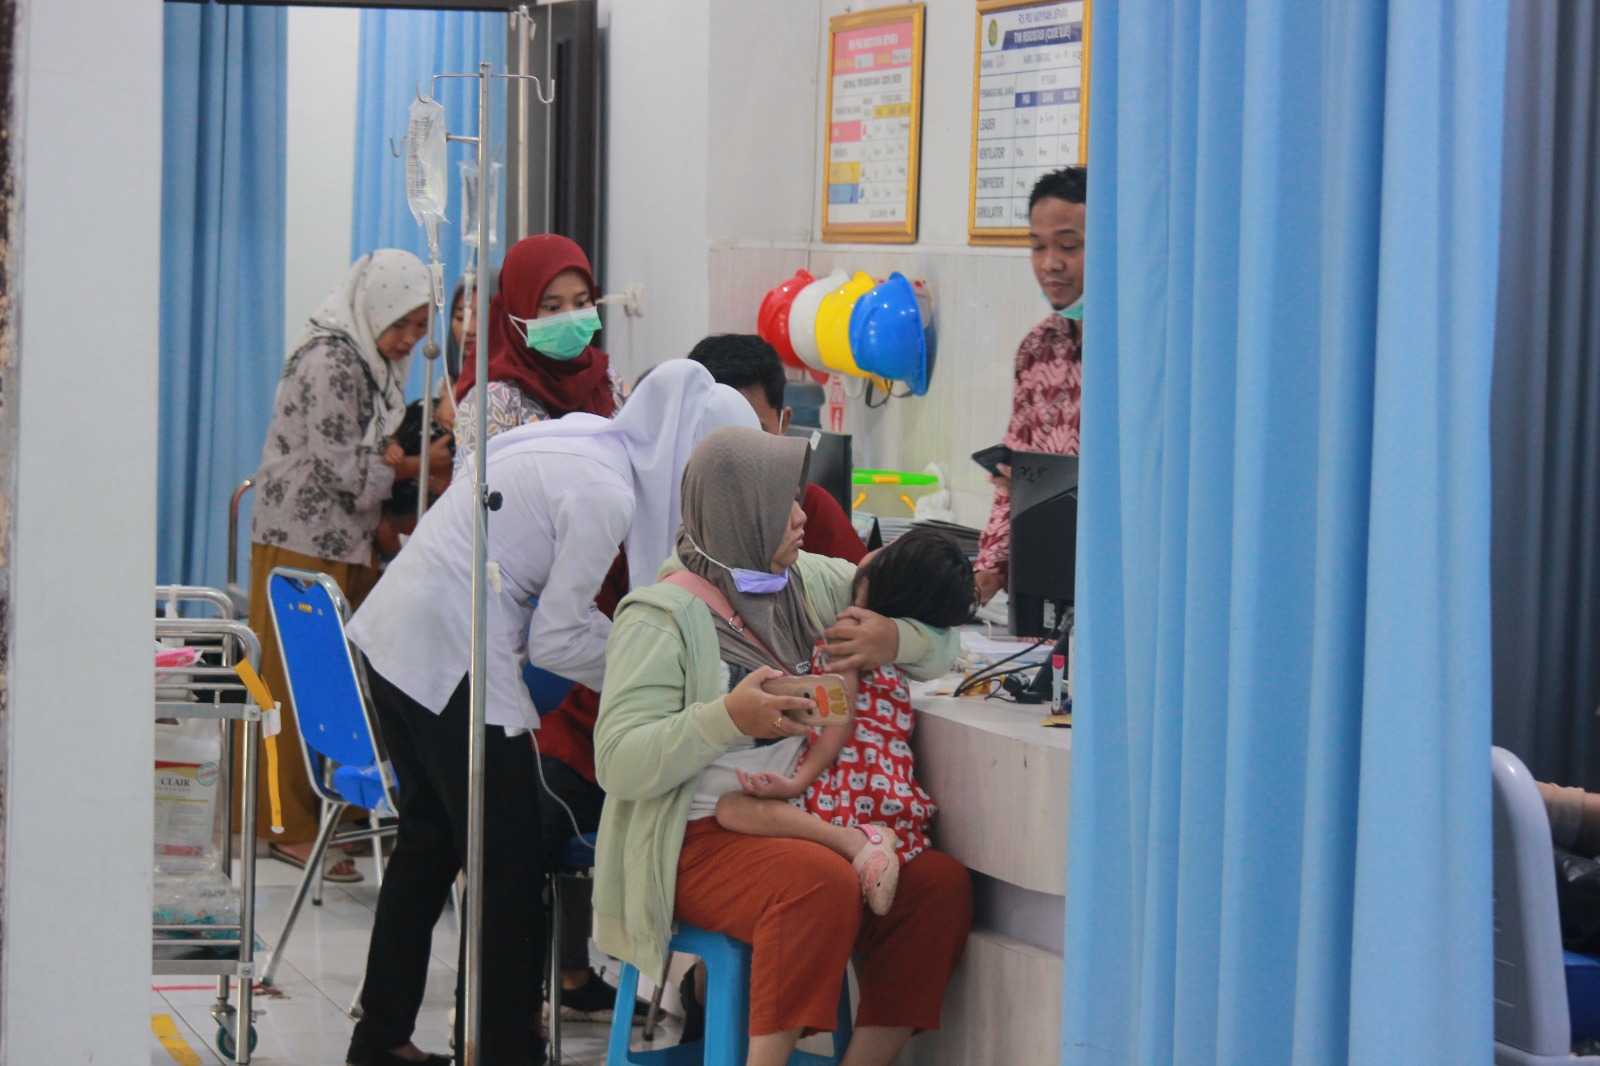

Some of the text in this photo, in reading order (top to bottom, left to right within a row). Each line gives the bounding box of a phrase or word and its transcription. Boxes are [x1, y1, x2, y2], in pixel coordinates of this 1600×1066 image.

[979, 118, 996, 131] LEADER
[979, 146, 1005, 160] VENTILATOR
[160, 777, 191, 787] CLAIR
